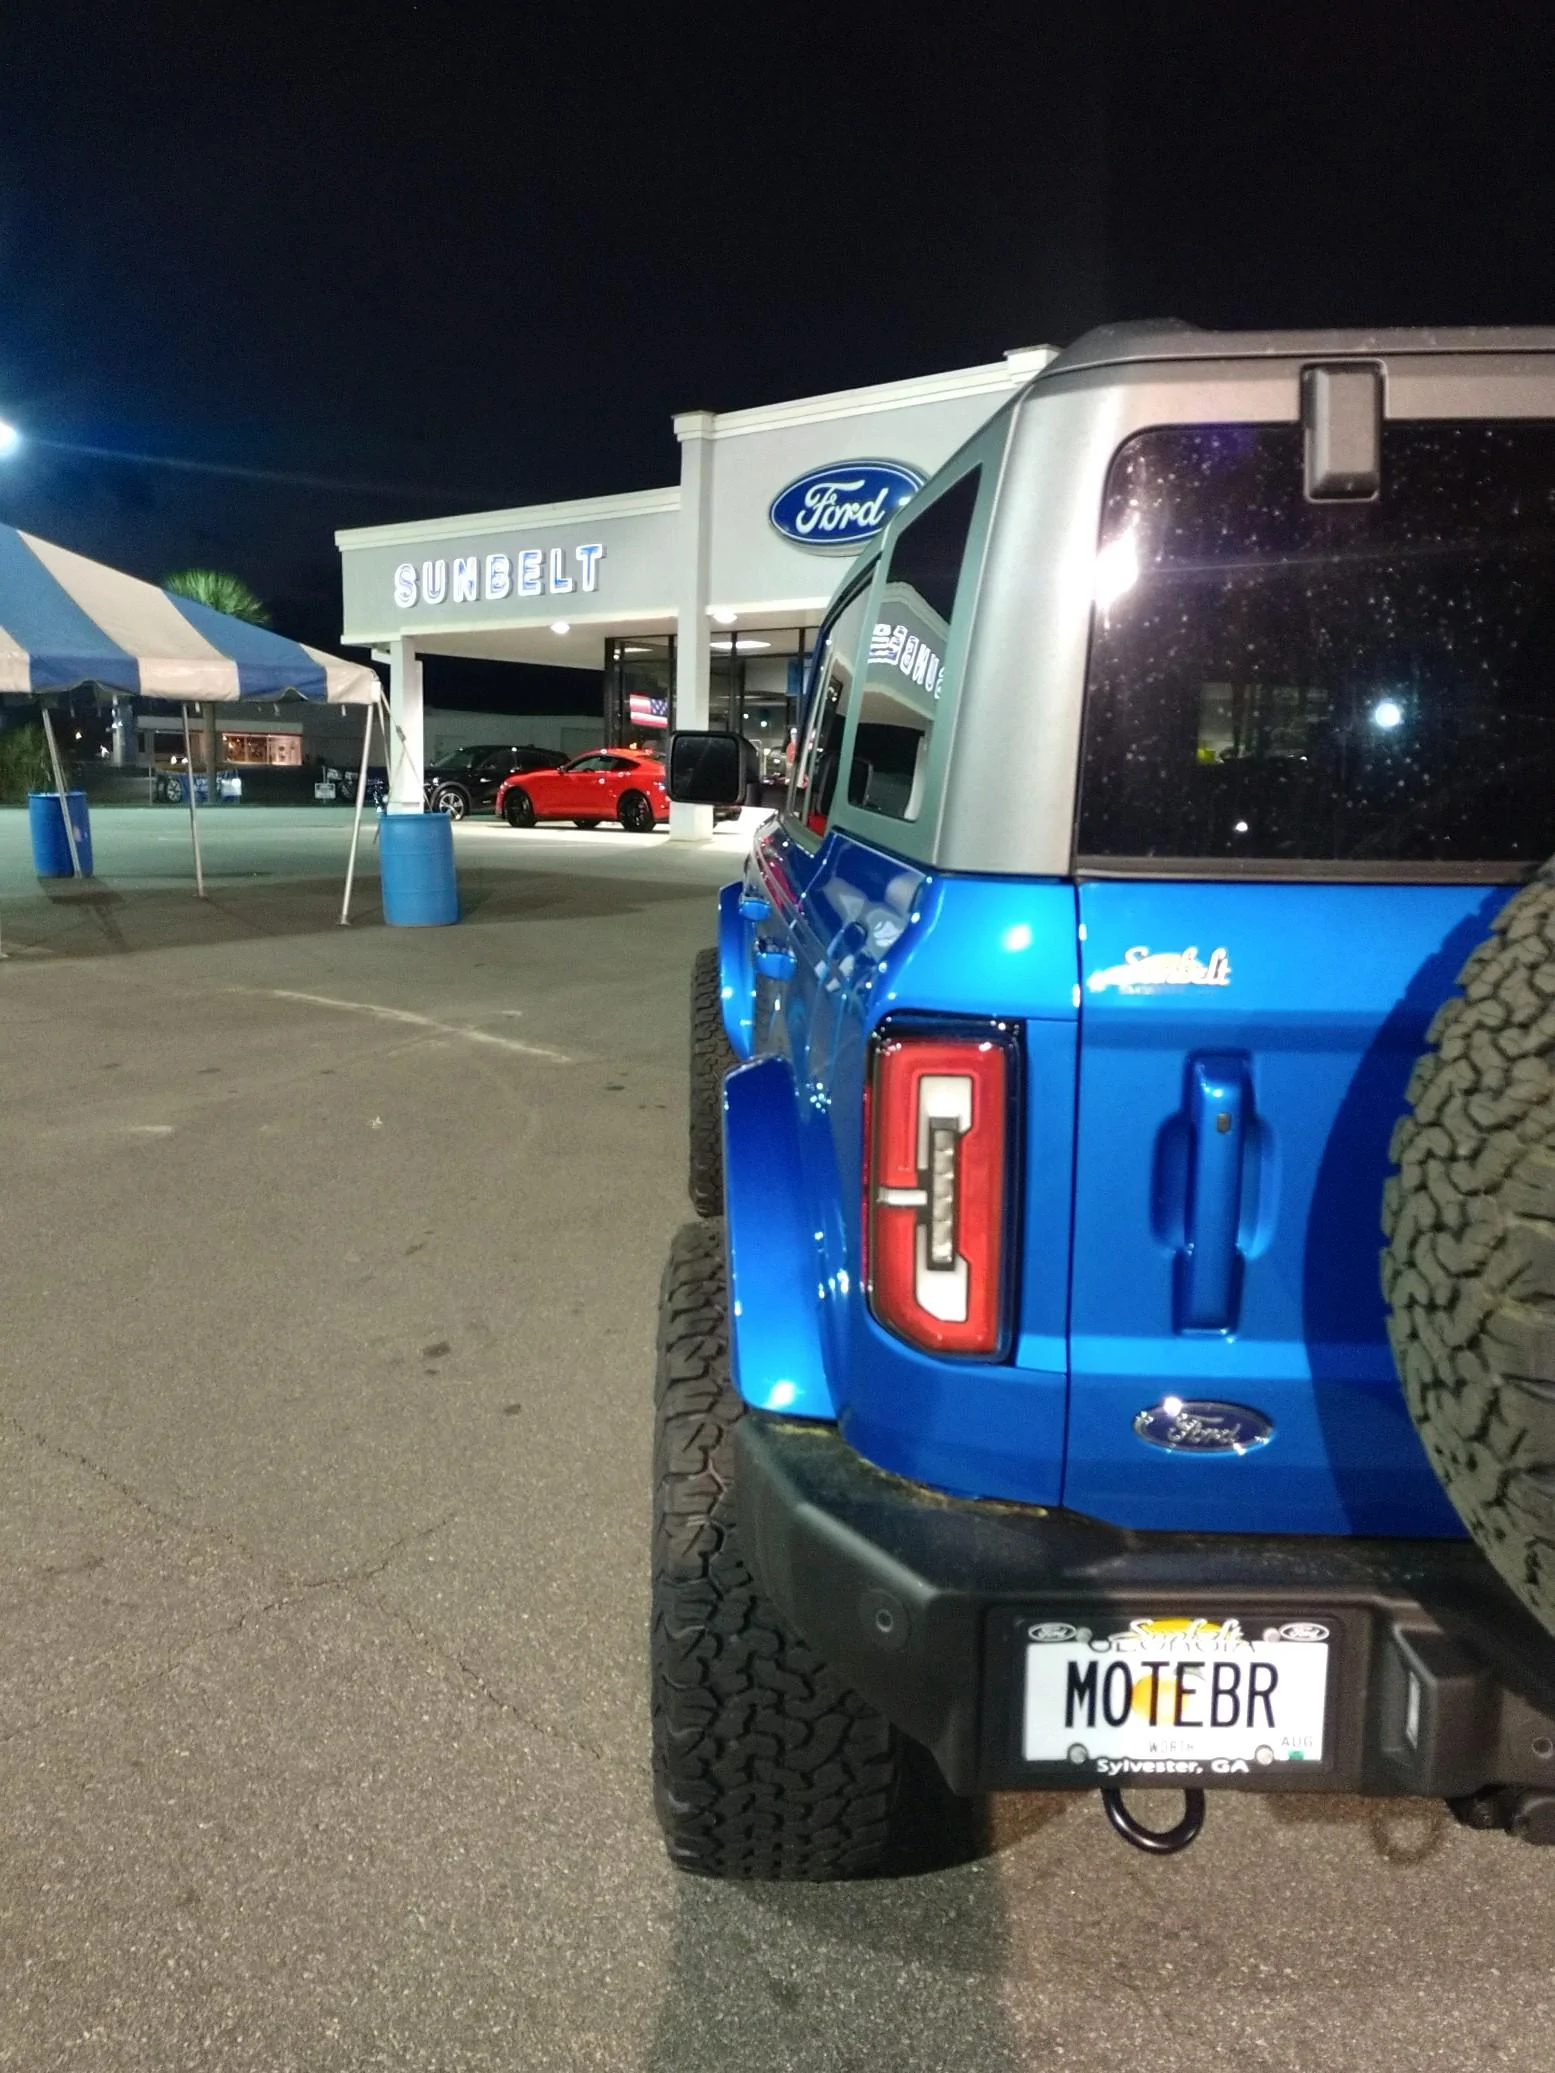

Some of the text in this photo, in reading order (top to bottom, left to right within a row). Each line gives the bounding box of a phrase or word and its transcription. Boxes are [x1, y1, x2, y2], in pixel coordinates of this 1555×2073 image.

[795, 479, 889, 534] Ford
[394, 544, 603, 608] SUNBELT
[1167, 1413, 1242, 1443] Ford
[1065, 1660, 1279, 1728] MOTEBR
[1281, 1735, 1313, 1748] AUG
[1097, 1758, 1249, 1775] Sylvester, GA
